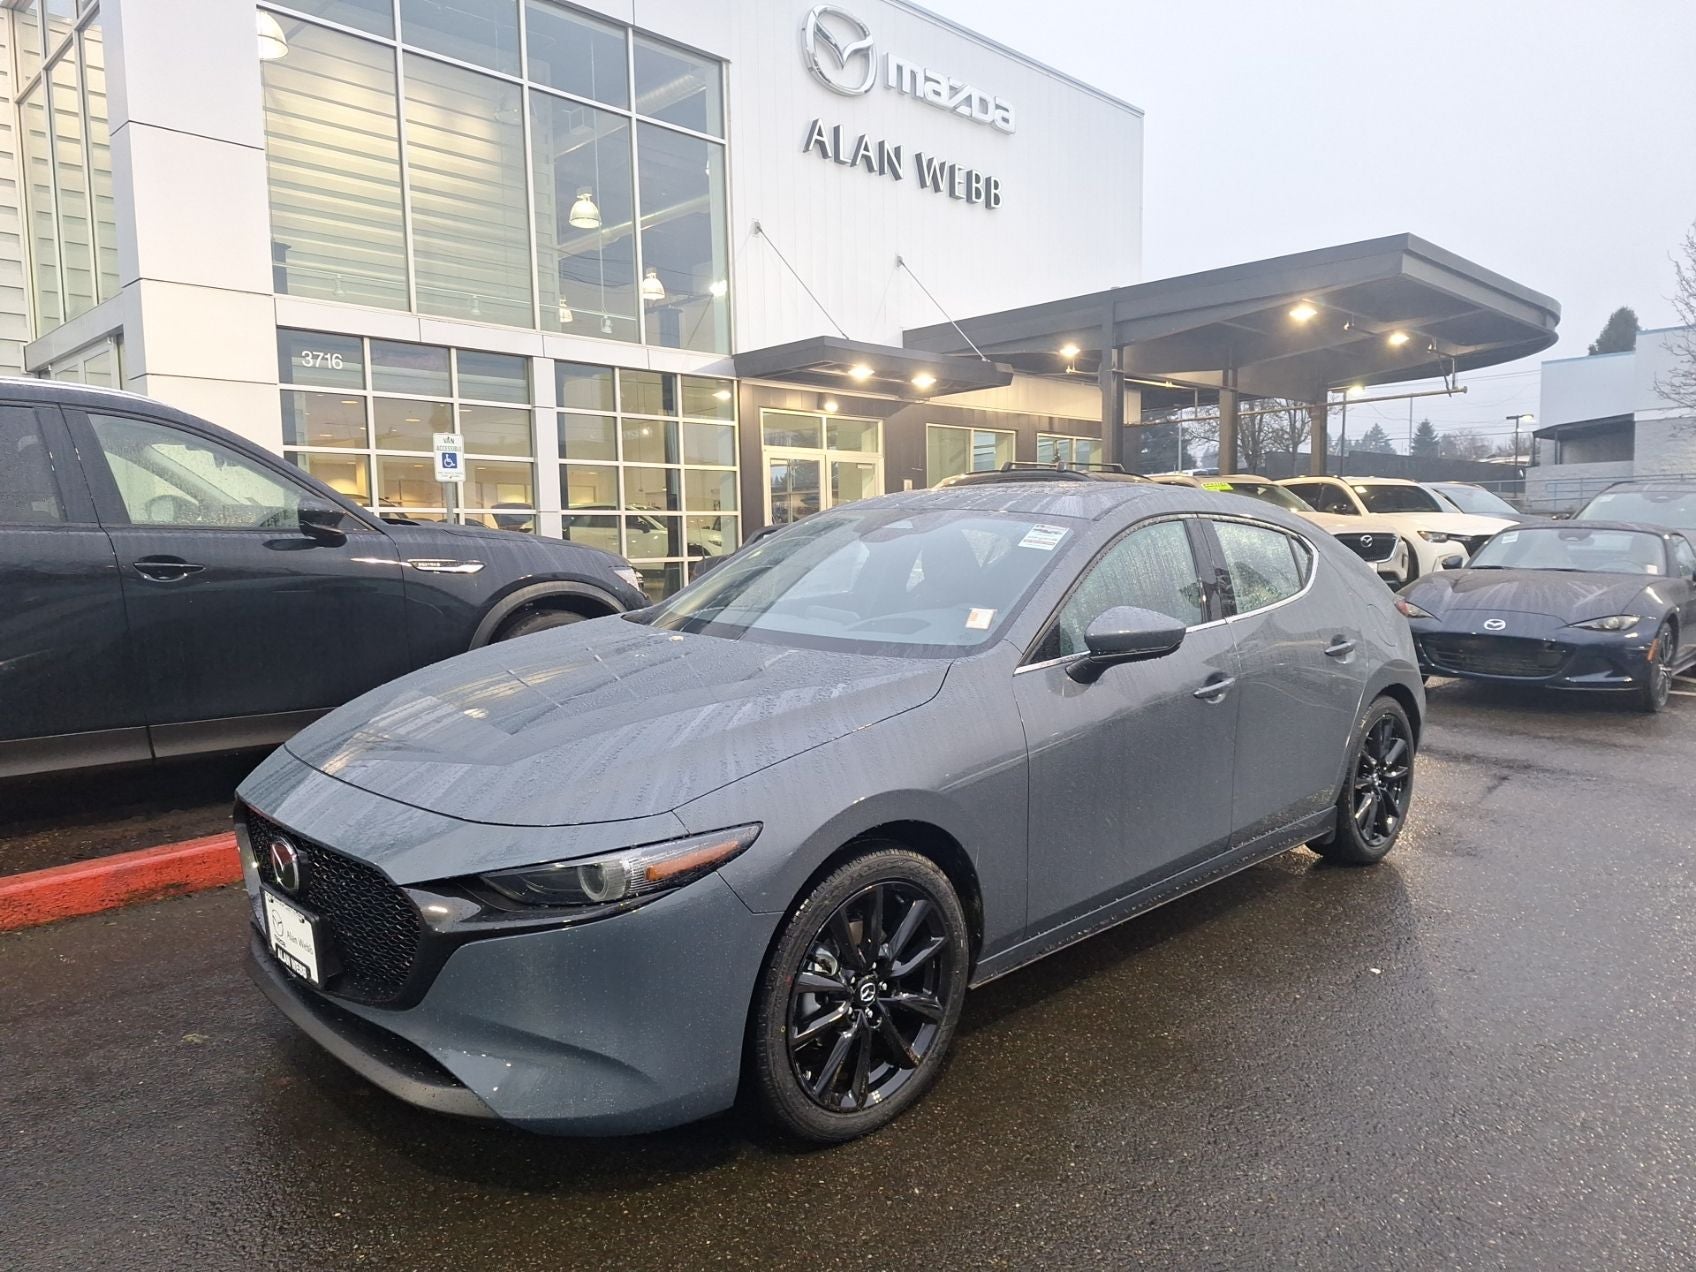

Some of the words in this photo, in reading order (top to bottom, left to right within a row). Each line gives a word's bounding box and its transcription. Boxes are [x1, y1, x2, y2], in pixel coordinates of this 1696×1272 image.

[803, 117, 903, 181] ALAN
[914, 151, 1002, 210] WEBB
[301, 350, 343, 370] 3716
[443, 436, 455, 444] VAN
